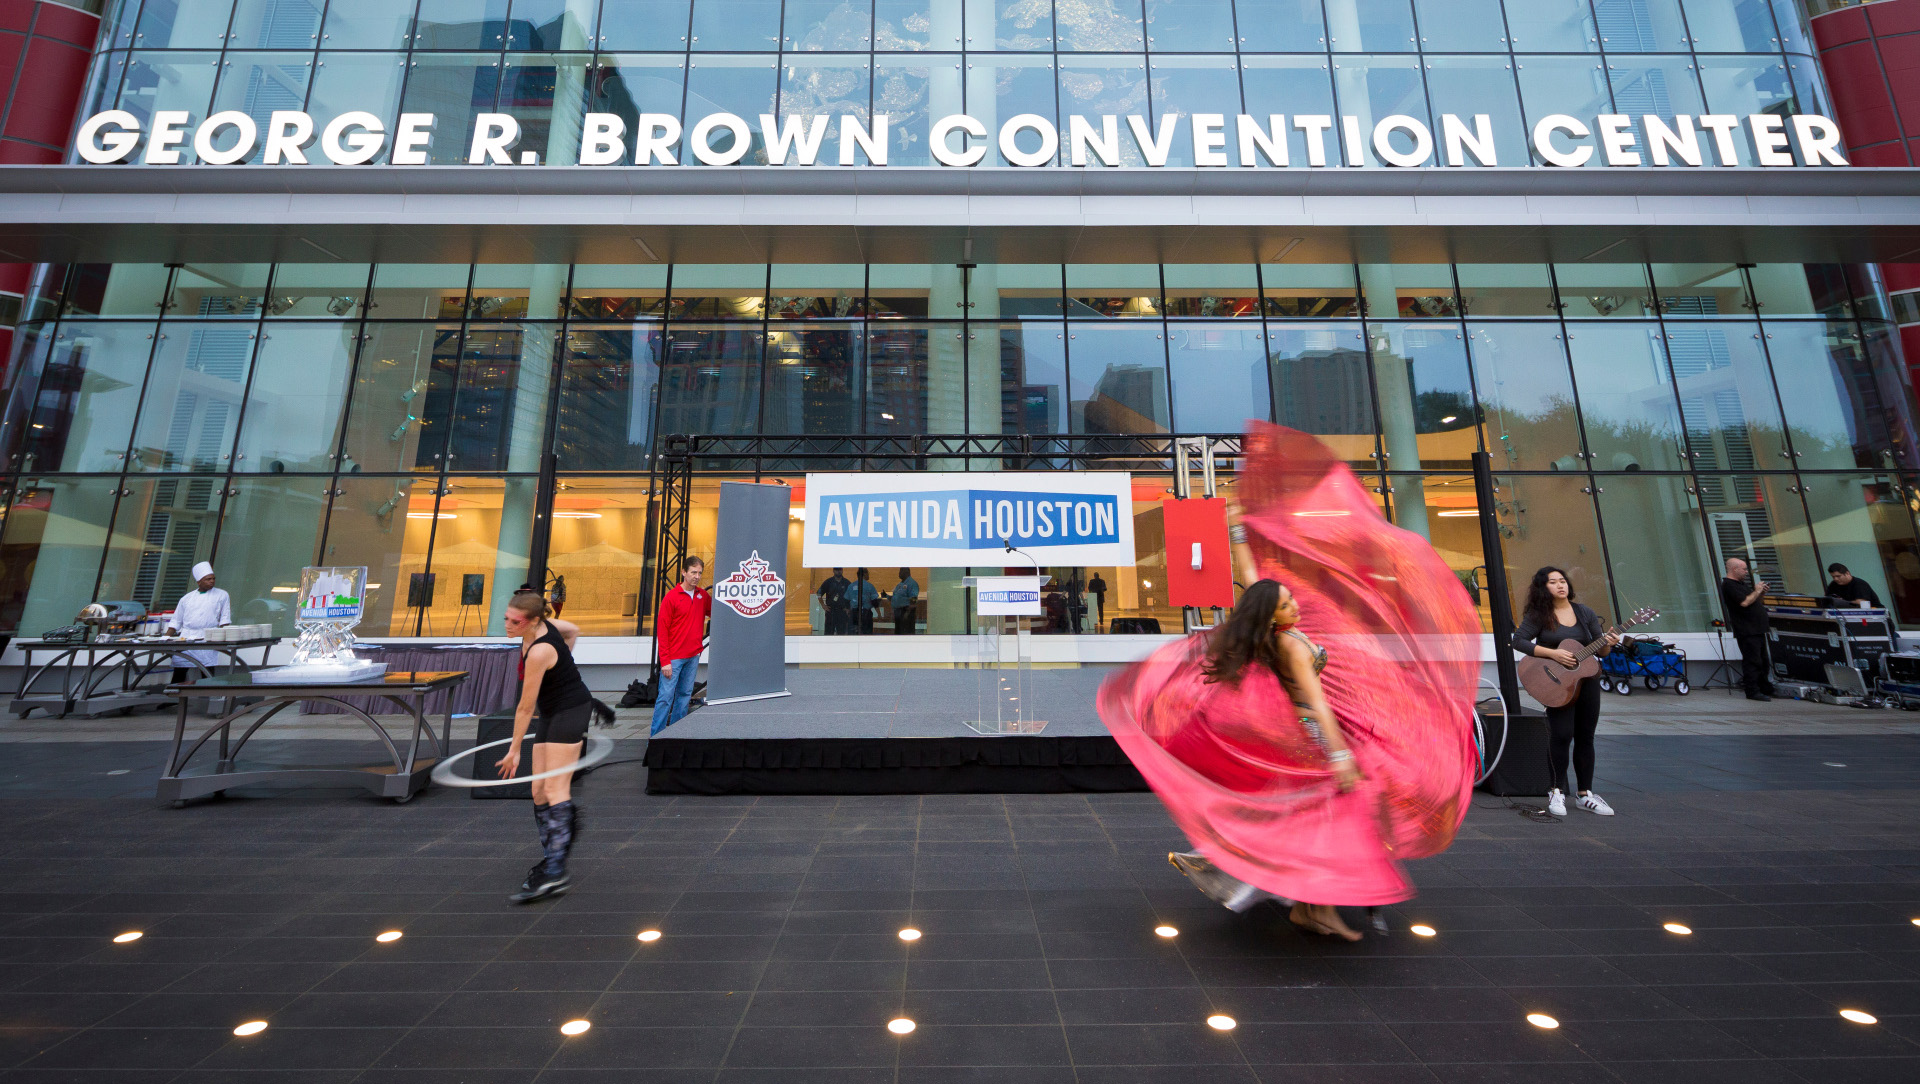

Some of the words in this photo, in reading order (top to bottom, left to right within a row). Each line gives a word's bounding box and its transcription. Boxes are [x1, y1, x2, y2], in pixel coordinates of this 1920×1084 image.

[75, 109, 437, 166] GEORGE
[469, 113, 540, 166] R.
[578, 112, 889, 167] BROWN
[928, 113, 1498, 168] CONVENTION
[1531, 113, 1851, 168] CENTER
[823, 499, 964, 540] AVENIDA
[974, 499, 1115, 540] HOUSTON
[717, 584, 784, 597] HOUSTON
[980, 592, 1008, 601] AVENIDA
[1010, 592, 1038, 601] HOUSTON
[301, 609, 327, 617] AVENIDA
[329, 607, 356, 616] HOUSTON
[735, 602, 750, 614] SUPER
[751, 606, 765, 614] BOWL
